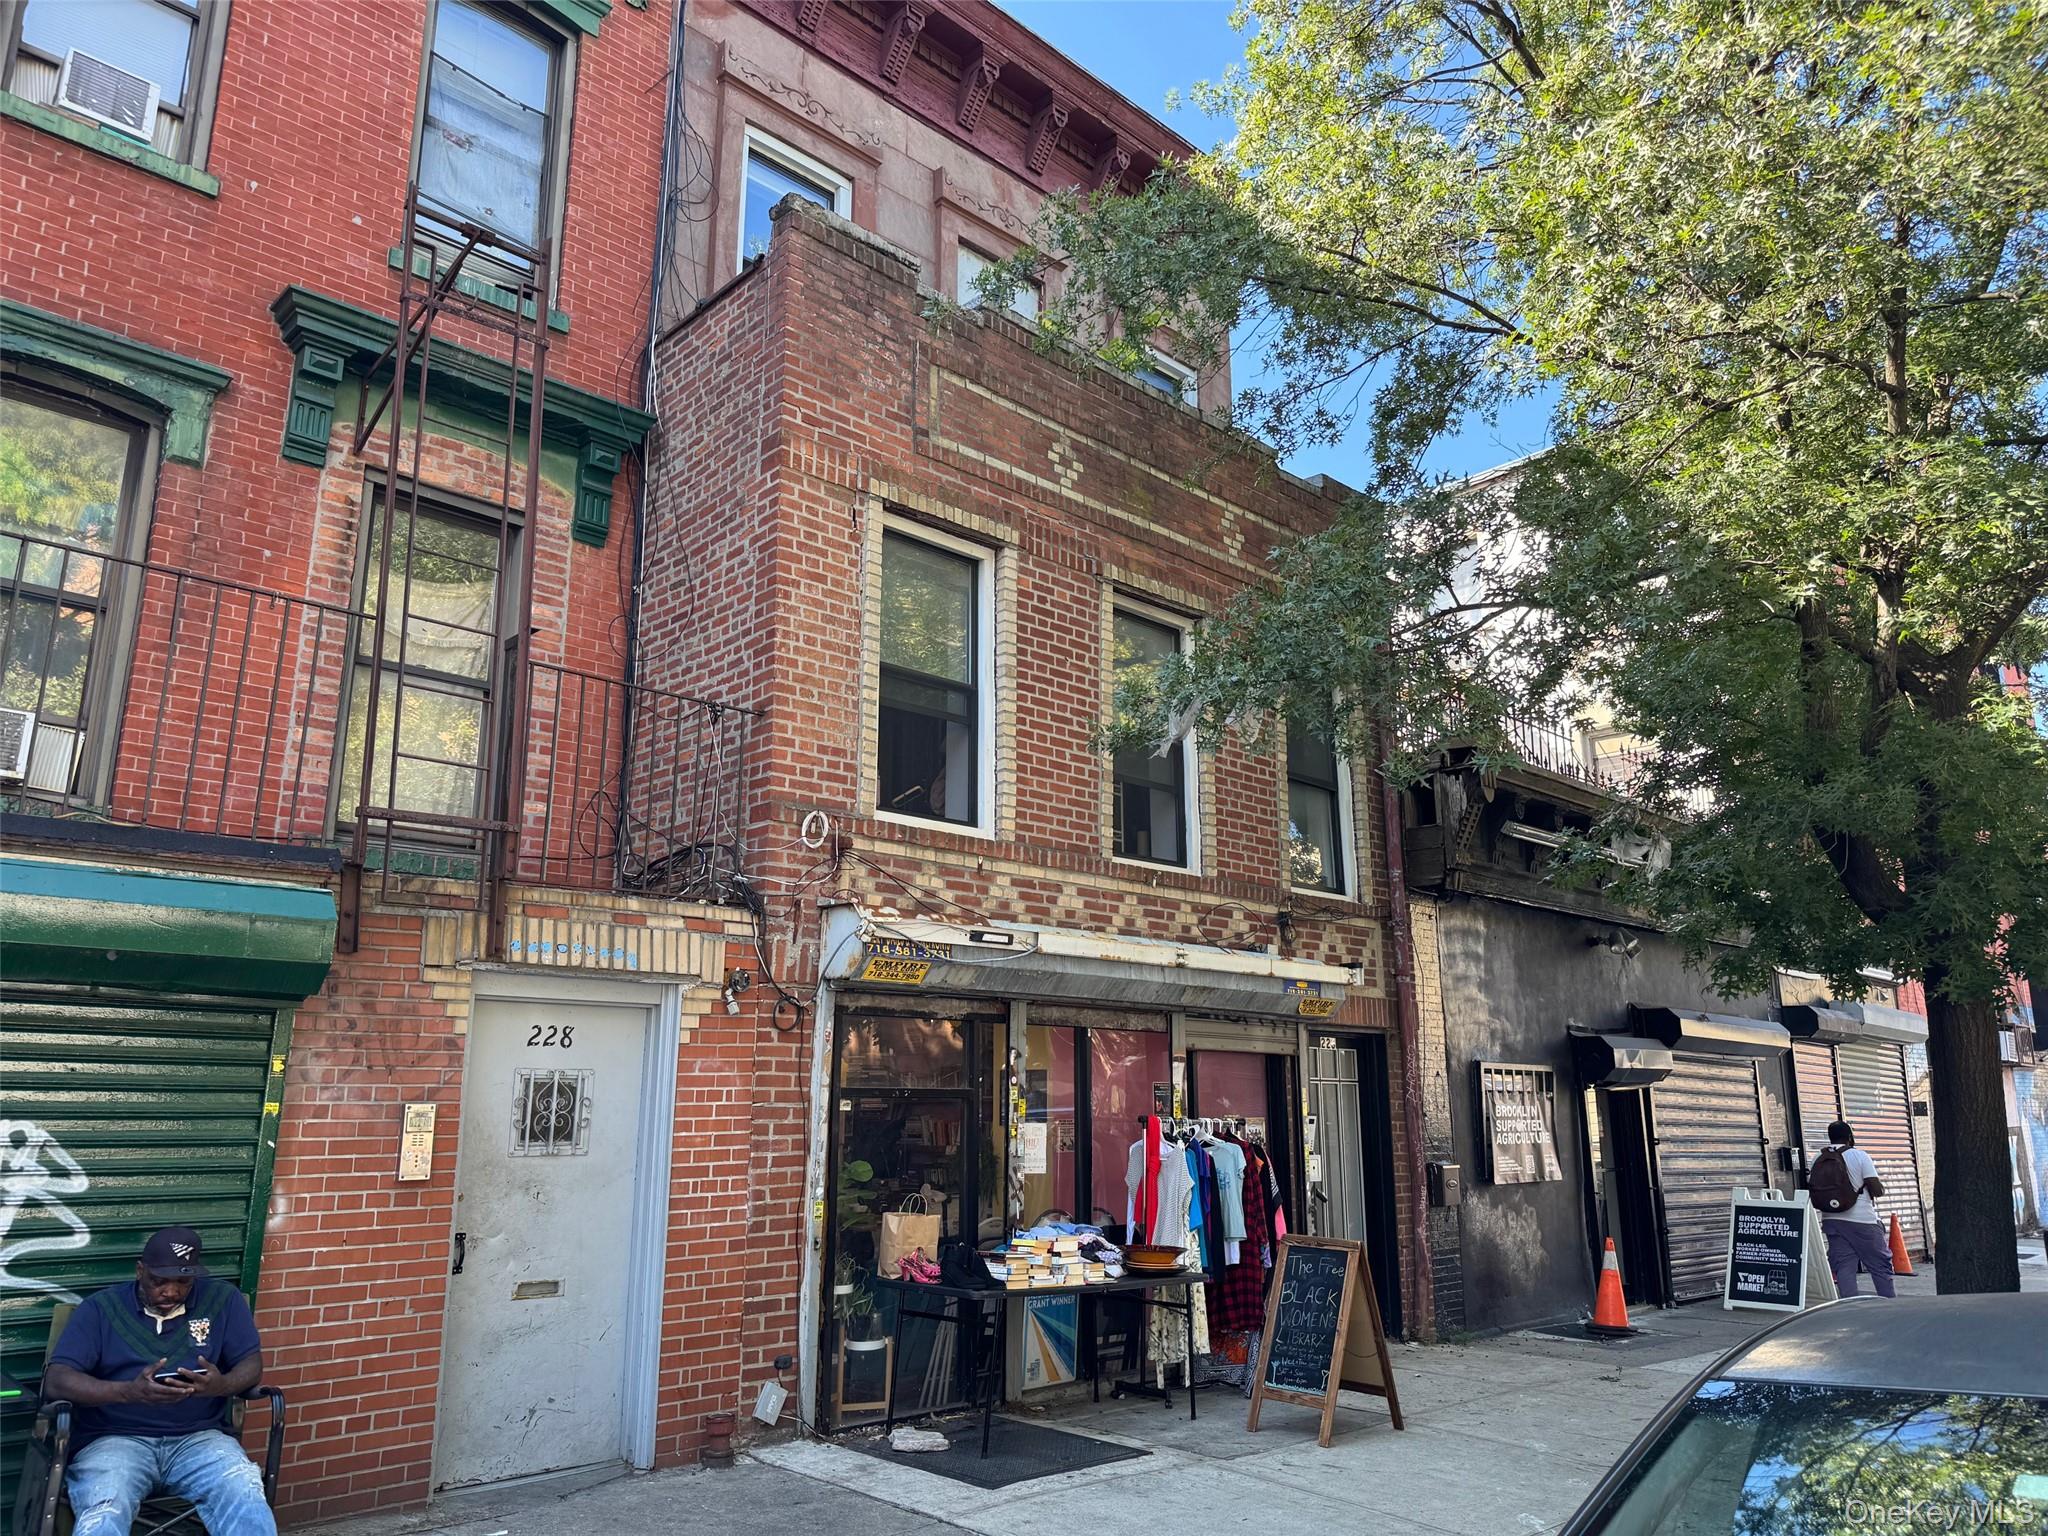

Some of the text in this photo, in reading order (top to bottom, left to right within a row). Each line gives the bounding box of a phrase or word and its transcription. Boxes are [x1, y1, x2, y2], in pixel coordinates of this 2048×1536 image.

[872, 960, 929, 970] EMPIRE
[527, 1024, 575, 1049] 228
[1495, 1105, 1537, 1117] BROOKLYN
[1496, 1118, 1543, 1131] SUPPORTED
[1496, 1132, 1551, 1145] AGRICULTURE
[1738, 1215, 1786, 1224] BROOKLYN
[1738, 1222, 1790, 1231] SUPPORTED
[1737, 1228, 1799, 1238] AGRICULTURE
[1288, 1256, 1344, 1277] The Free
[1747, 1274, 1765, 1283] OPEN
[1737, 1282, 1764, 1292] MARKET
[1280, 1280, 1338, 1308] BLACK
[1028, 1299, 1049, 1309] GRANT
[1051, 1295, 1075, 1306] WINNER
[1275, 1327, 1326, 1348] LIBRARY
